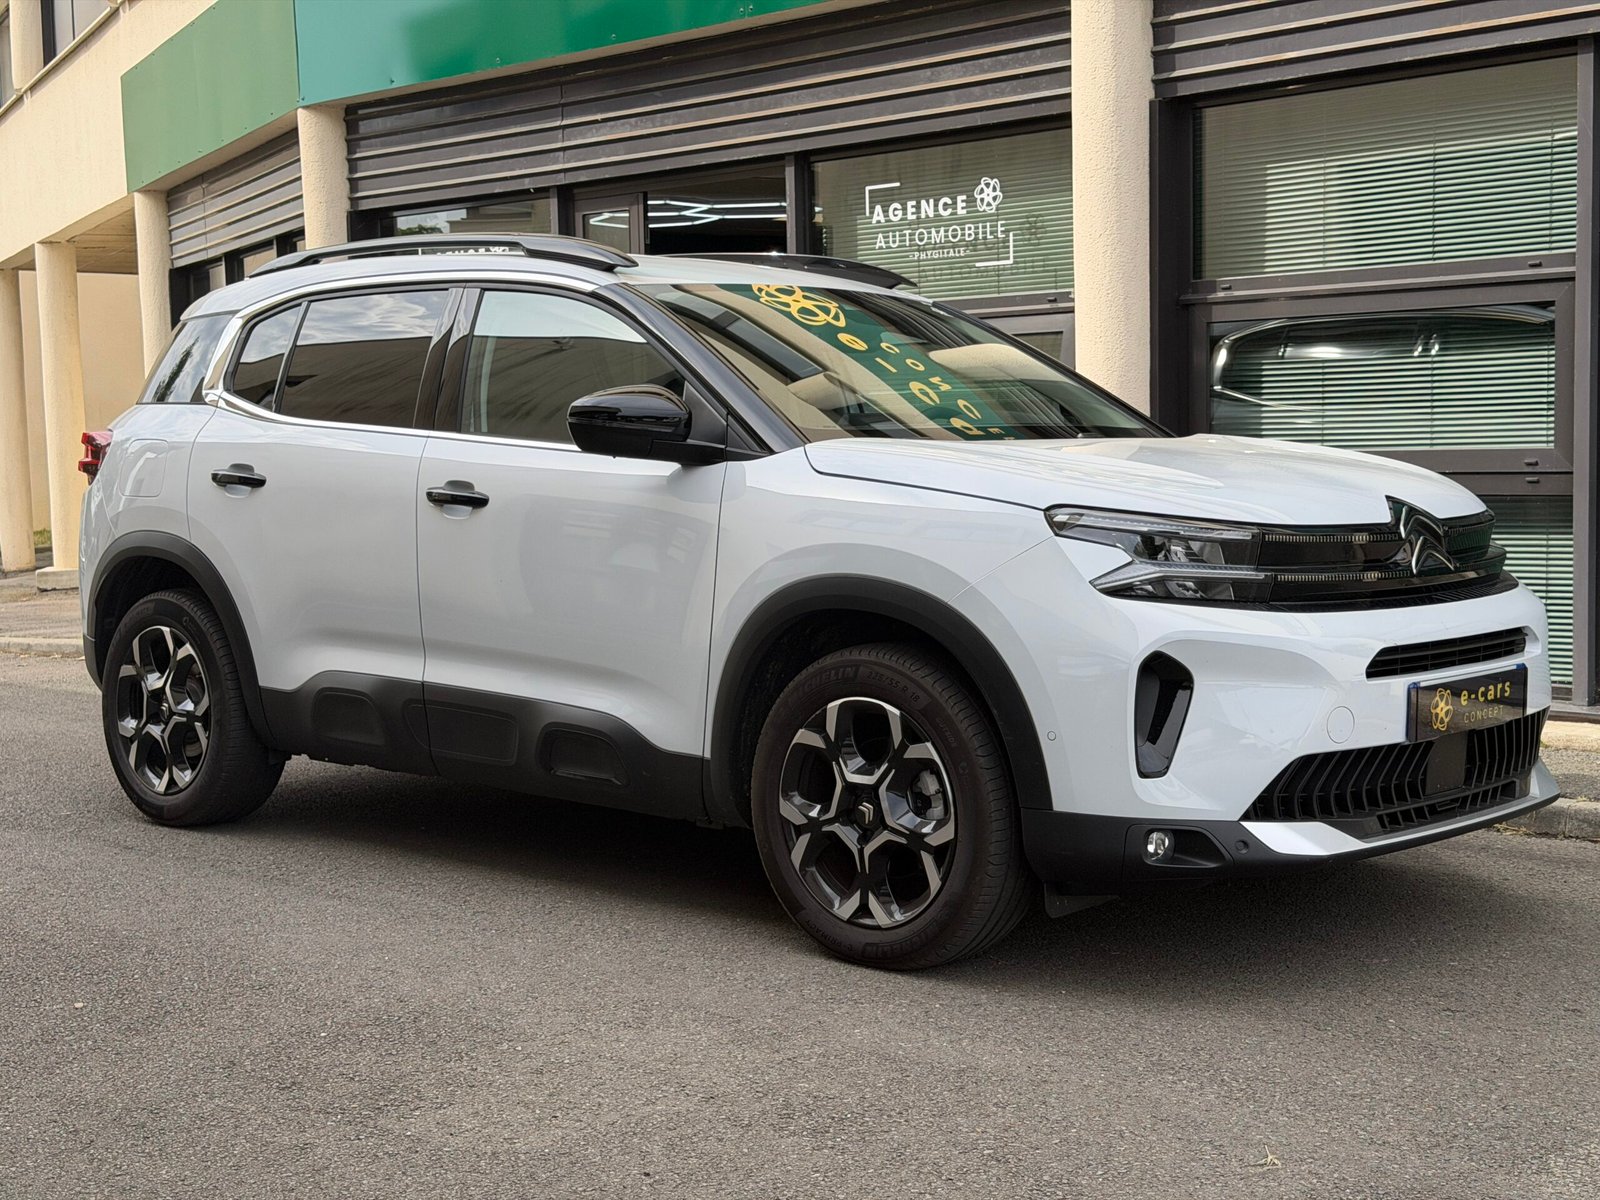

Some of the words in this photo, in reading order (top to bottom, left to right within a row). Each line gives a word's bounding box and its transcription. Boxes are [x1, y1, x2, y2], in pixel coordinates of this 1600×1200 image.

[871, 195, 968, 224] AGENCE
[875, 220, 1006, 250] AUTOMOBILE
[910, 692, 921, 702] 18
[1460, 681, 1511, 705] e-cars
[1463, 705, 1504, 723] CONCEPT
